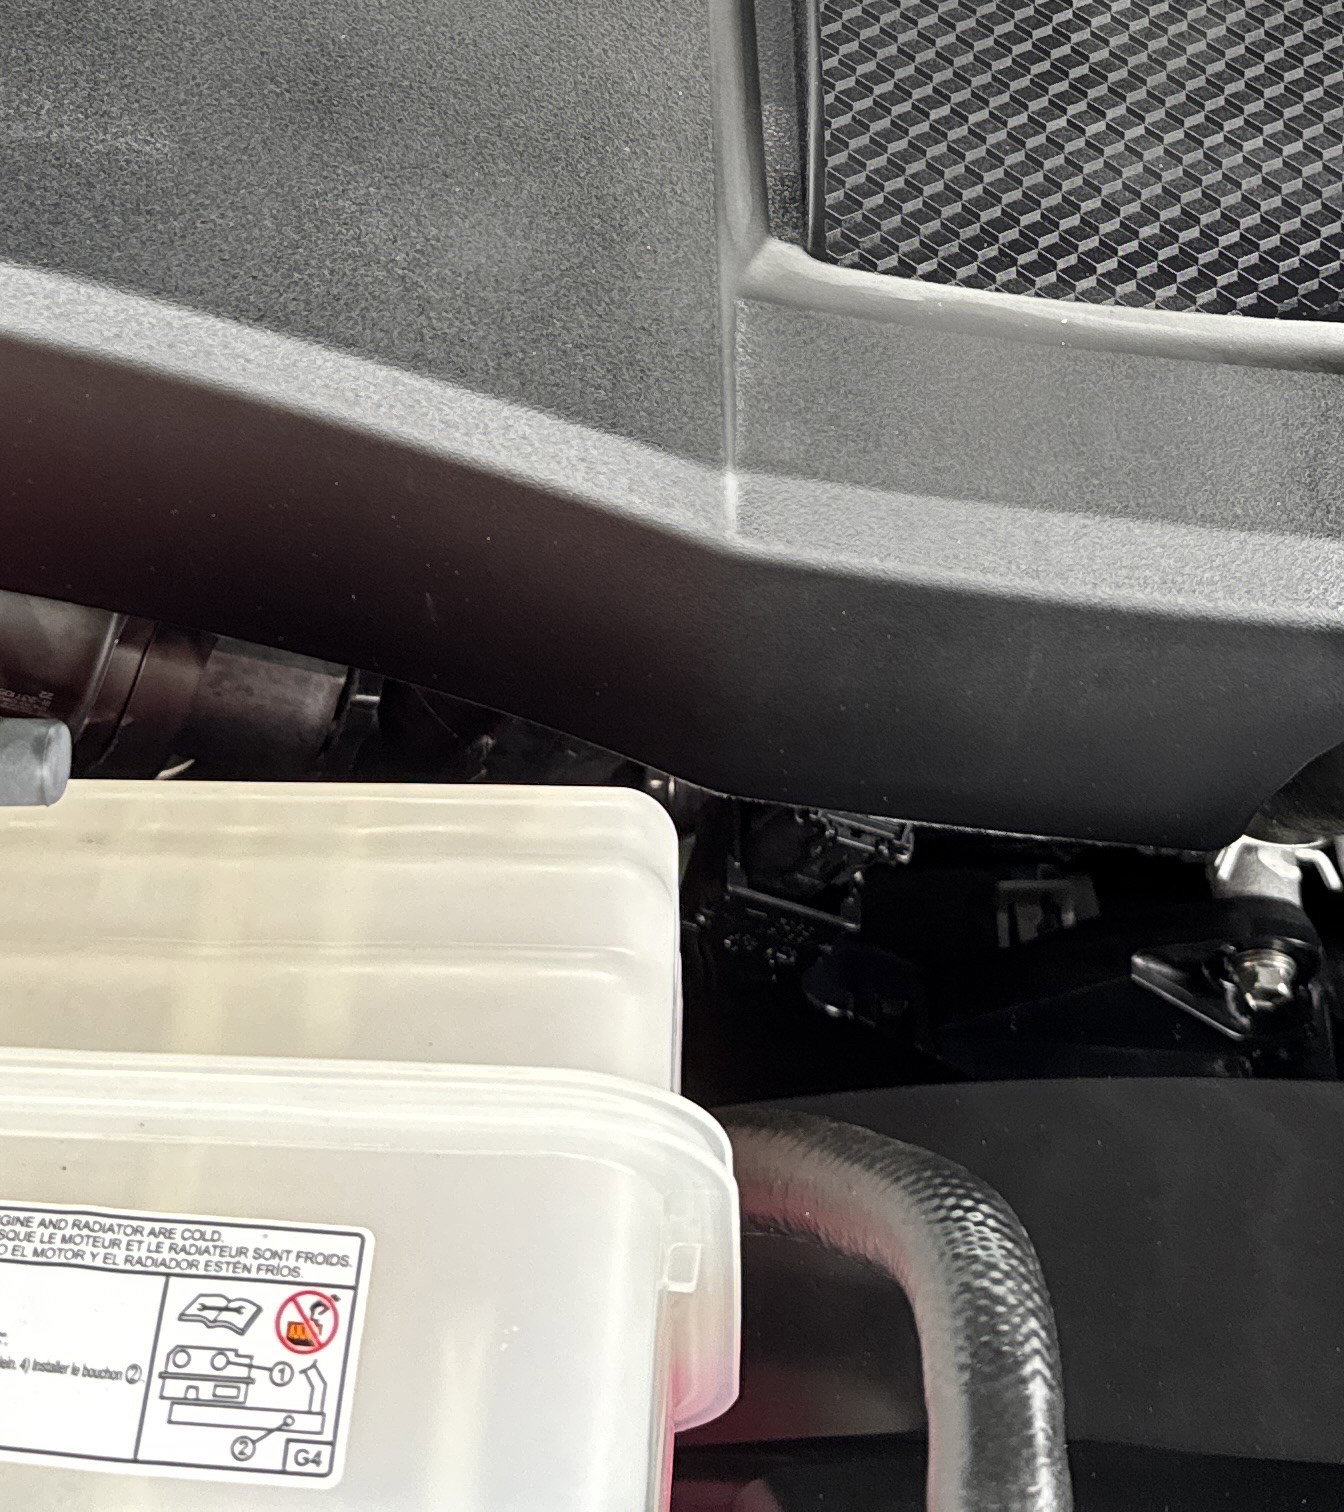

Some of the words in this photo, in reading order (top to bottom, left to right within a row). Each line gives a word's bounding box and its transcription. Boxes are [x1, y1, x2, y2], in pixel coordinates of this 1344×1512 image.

[37, 1218, 69, 1231] AND
[71, 1219, 145, 1237] RADIATOR
[146, 1226, 177, 1240] ARE
[10, 1244, 26, 1258] EL
[32, 1247, 86, 1261] MOTOR
[89, 1250, 100, 1263] Y
[102, 1252, 120, 1266] EL
[123, 1254, 200, 1271] RADIADOR
[39, 1232, 58, 1245] LE
[60, 1233, 122, 1250] MOTEUR
[125, 1239, 145, 1252] ET
[146, 1241, 165, 1254] LE
[168, 1242, 249, 1259] RADIATEUR
[252, 1247, 293, 1262] SONT
[295, 1250, 351, 1268] FROIDS.
[293, 1448, 322, 1468] G4
